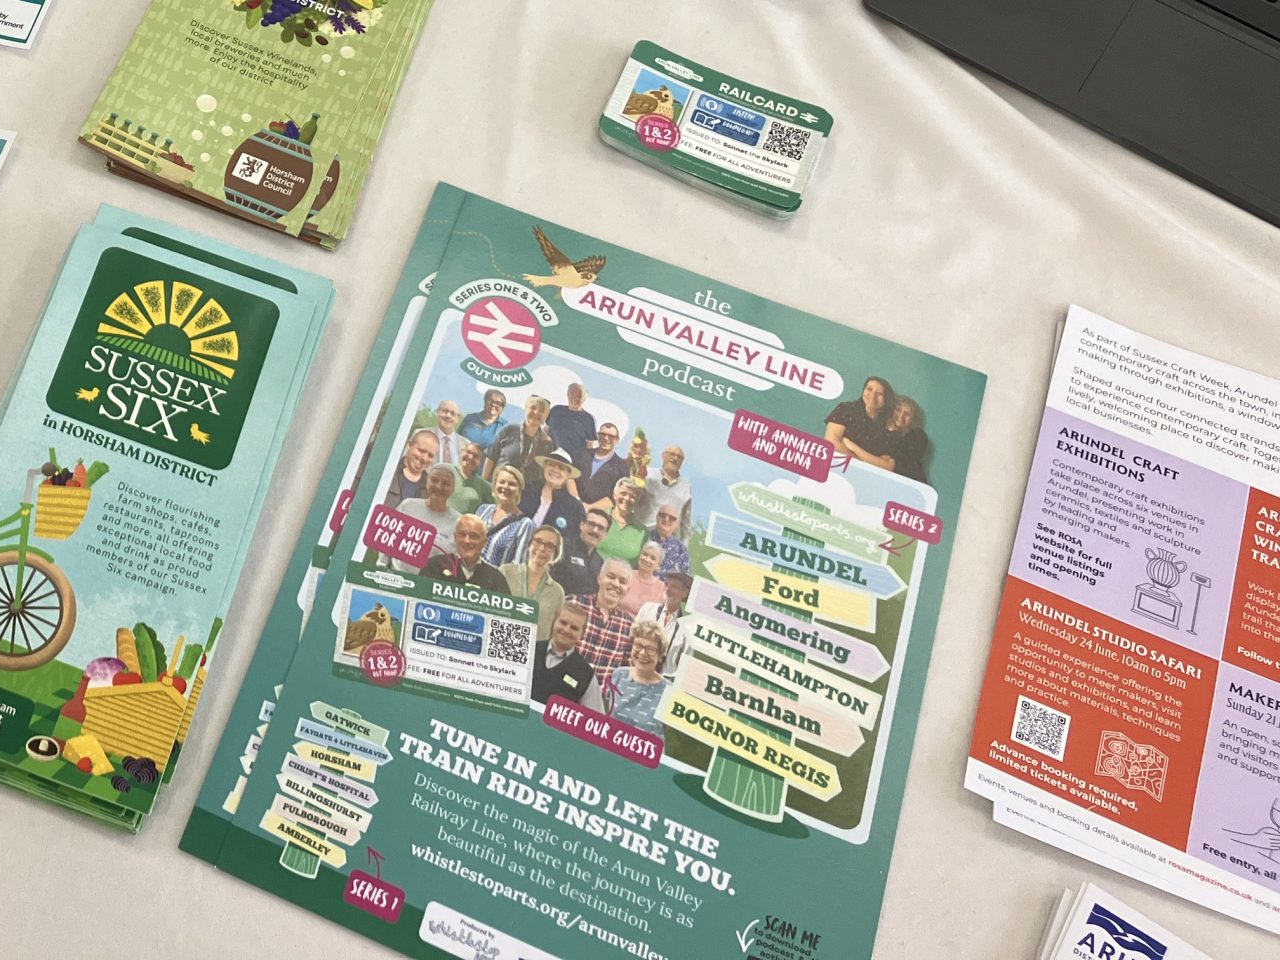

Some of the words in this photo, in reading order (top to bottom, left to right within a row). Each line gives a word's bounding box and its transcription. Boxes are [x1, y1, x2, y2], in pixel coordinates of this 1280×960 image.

[717, 83, 800, 117] RAILCARD
[694, 290, 731, 315] the
[578, 290, 655, 329] ARUN
[662, 317, 761, 366] VALLEY
[764, 355, 825, 391] LINE
[84, 345, 227, 415] SUSSEX
[641, 356, 736, 402] podcast
[98, 384, 188, 442] SIX
[738, 417, 768, 436] WITH
[771, 429, 827, 460] ANNALEES
[43, 414, 57, 430] in
[60, 420, 140, 460] HORSHAM
[142, 451, 218, 487] DISTRICT
[752, 437, 777, 455] AND
[780, 447, 811, 470] LUNA
[1057, 440, 1144, 482] EXHIBITIONS
[1059, 427, 1125, 460] ARUNDEL
[1133, 456, 1180, 480] CRAFT
[738, 533, 867, 586] ARUNDEL
[762, 576, 819, 608] Ford
[714, 595, 851, 664] Angmering
[1019, 611, 1078, 644] Wednesday
[1079, 636, 1093, 650] 24
[1093, 643, 1119, 662] June,
[1121, 654, 1149, 674] 10am
[1150, 667, 1162, 678] to
[1163, 671, 1186, 689] 5pm
[1021, 599, 1091, 635] ARUNDEL
[1090, 627, 1147, 656] STUDIO
[1150, 650, 1201, 679] SAFARI
[694, 625, 869, 715] LITTLEHAMPTON
[325, 711, 371, 736] GATWICK
[704, 674, 821, 736] Barnham
[670, 701, 758, 755] BOGNOR
[762, 746, 830, 788] REGIS
[286, 779, 362, 822] BILLINGSHURST
[399, 732, 484, 785] TRAIN
[486, 771, 552, 814] RIDE
[555, 801, 668, 865] INSPIRE
[673, 849, 735, 896] YOU.
[430, 718, 502, 765] TUNE
[505, 751, 537, 779] IN
[540, 767, 600, 806] AND
[605, 794, 658, 831] LET
[664, 817, 719, 859] THE
[277, 823, 331, 855] AMBERLEY
[282, 802, 348, 836] PULBOROUGH
